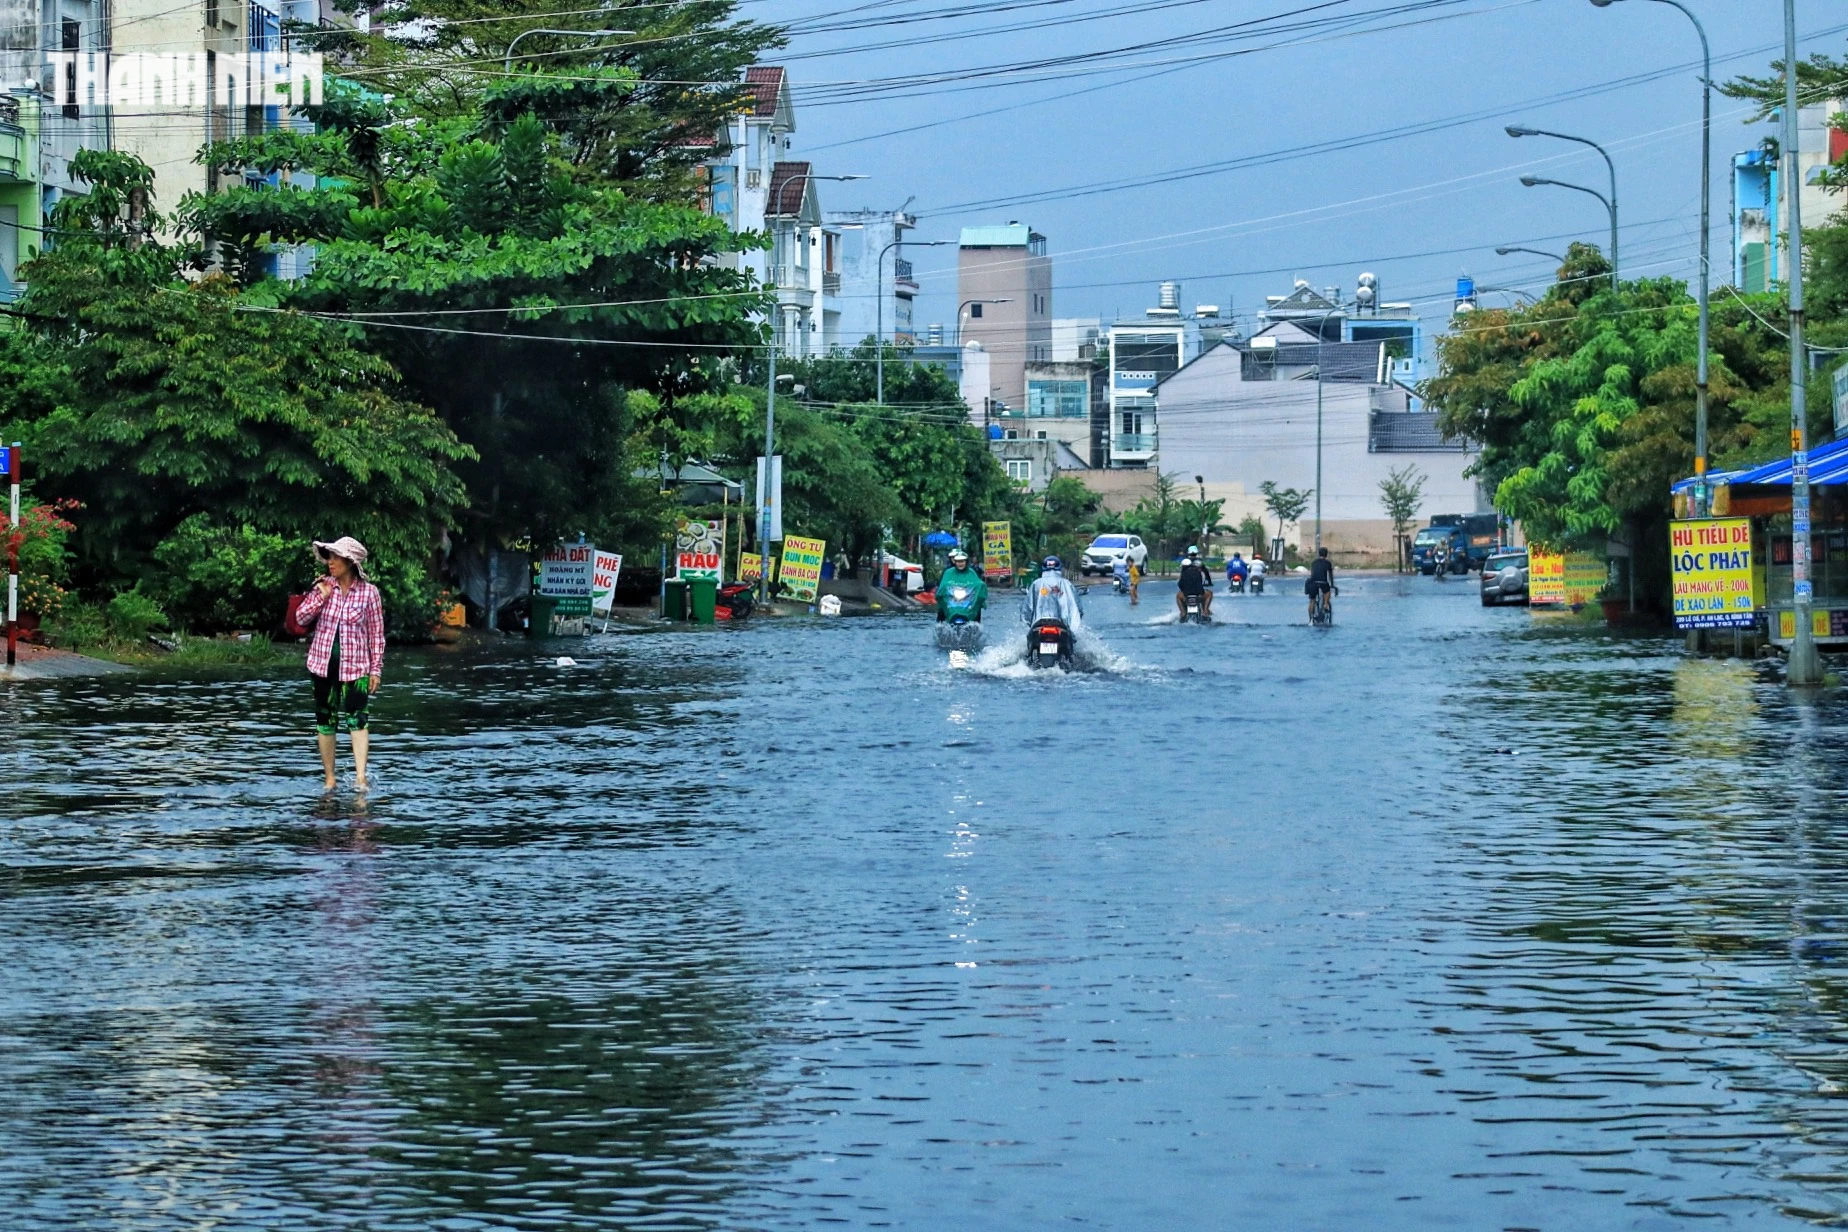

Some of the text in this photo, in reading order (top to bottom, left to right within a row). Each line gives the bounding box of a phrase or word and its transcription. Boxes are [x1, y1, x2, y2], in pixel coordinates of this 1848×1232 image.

[1673, 522, 1749, 546] HỦ TIẾU DÊ
[569, 546, 591, 561] ĐẤT
[1674, 547, 1749, 575] LỘC PHÁT
[596, 556, 618, 571] PHÊ
[594, 573, 612, 588] NG
[1674, 577, 1688, 594] LẨU
[1690, 581, 1713, 593] MANG
[1715, 577, 1724, 592] VỀ
[1730, 579, 1749, 591] 200k
[1675, 596, 1685, 611] DÊ
